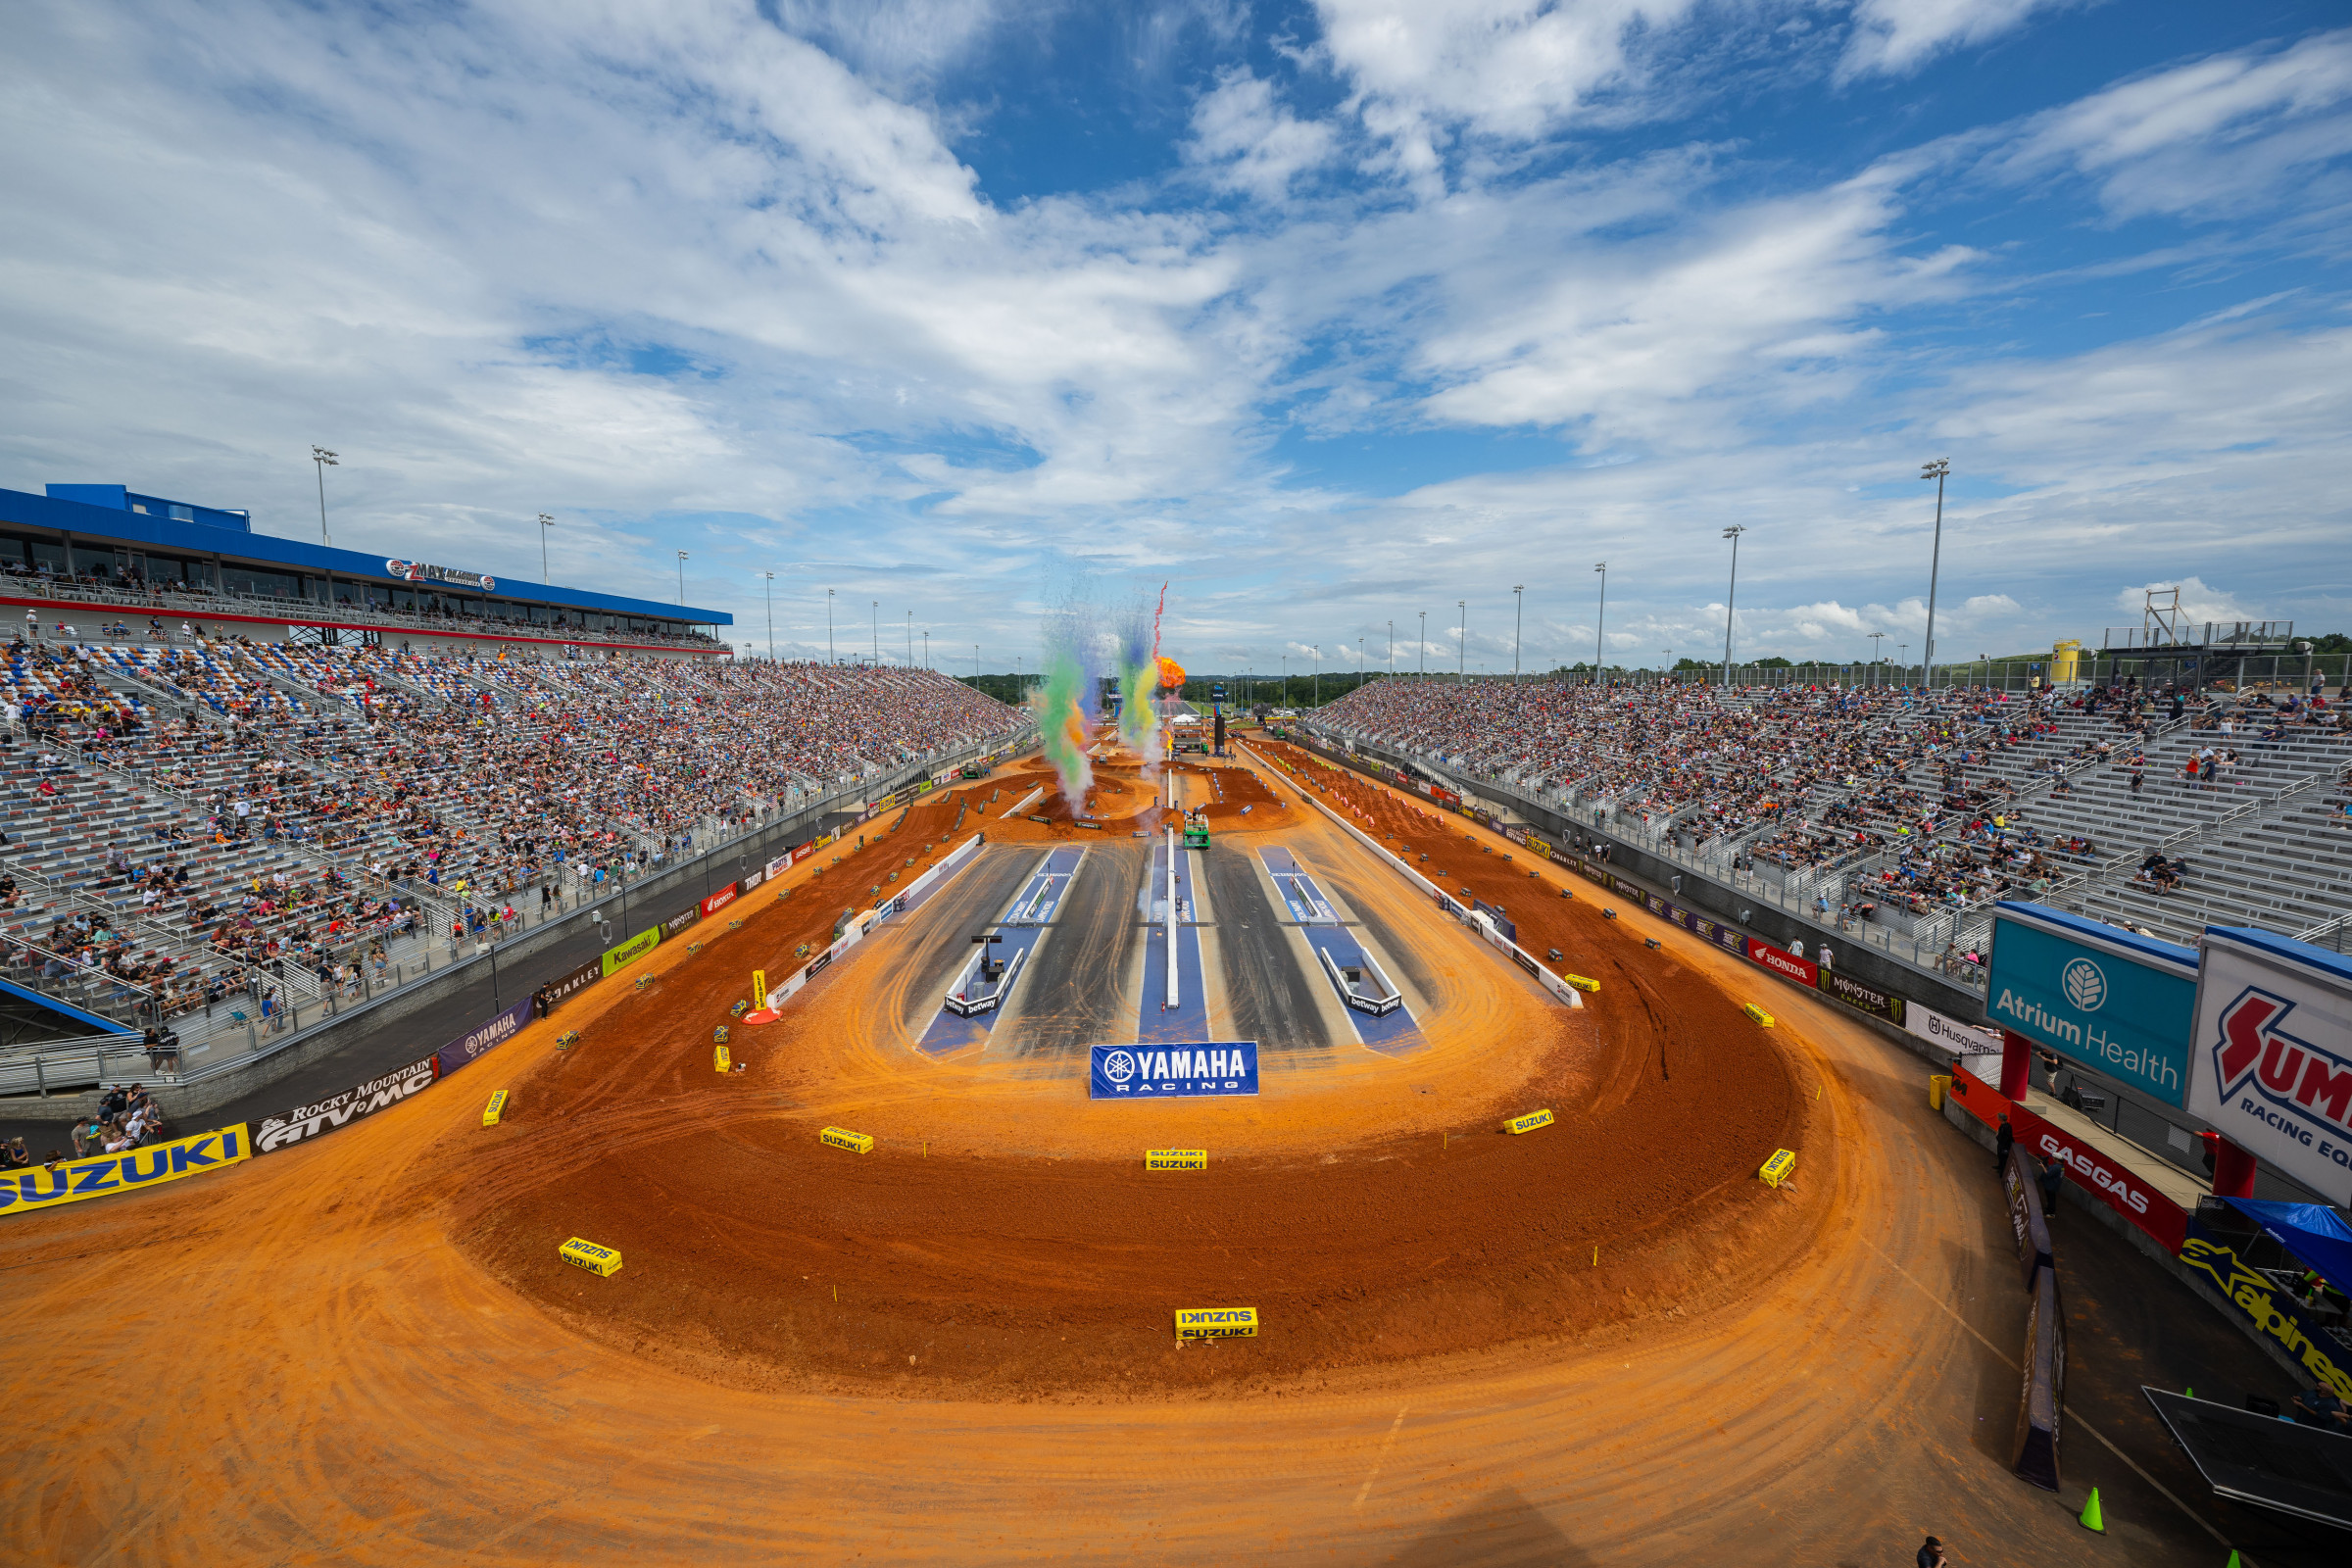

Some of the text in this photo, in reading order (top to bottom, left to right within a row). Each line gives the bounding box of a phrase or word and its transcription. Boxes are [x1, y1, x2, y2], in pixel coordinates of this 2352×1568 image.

[1527, 837, 1548, 857] SUZUKI
[772, 857, 787, 870] PARTS
[745, 871, 761, 891] THOR
[1616, 880, 1639, 898] MONSTER
[713, 891, 734, 908] HONDA
[669, 909, 694, 929] MONSTER
[613, 935, 652, 965] Kawasaki
[1766, 954, 1807, 979] HONDA
[1834, 977, 1885, 1007] MONSTER
[946, 998, 963, 1014] betway
[968, 999, 997, 1013] betway
[1351, 997, 1379, 1013] betway
[1381, 999, 1399, 1012] betway
[1841, 993, 1877, 1012] ENERGY
[476, 1013, 516, 1047] YAMAHA
[1996, 989, 2178, 1090] Atrium Health
[470, 1029, 515, 1057] RACING
[1137, 1050, 1246, 1080] YAMAHA
[2221, 997, 2352, 1129] SUM
[290, 1058, 430, 1124] ROCKY MOUNTAIN
[1116, 1081, 1238, 1092] RACING
[488, 1091, 504, 1113] SUZUKI
[1516, 1112, 1551, 1130] SUZUKI
[823, 1135, 860, 1152] SUZUKI
[827, 1128, 867, 1141] SUZUKI
[2240, 1098, 2352, 1173] RACING EQ
[0, 1132, 238, 1209] SUZUKI
[1765, 1151, 1789, 1172] SUZUKI
[2039, 1134, 2149, 1214] GASGAS
[565, 1241, 612, 1258] SUZUKI
[563, 1253, 603, 1274] SUZUKI
[1182, 1311, 1252, 1323] SUZUKI
[1182, 1328, 1253, 1338] SUZUKI
